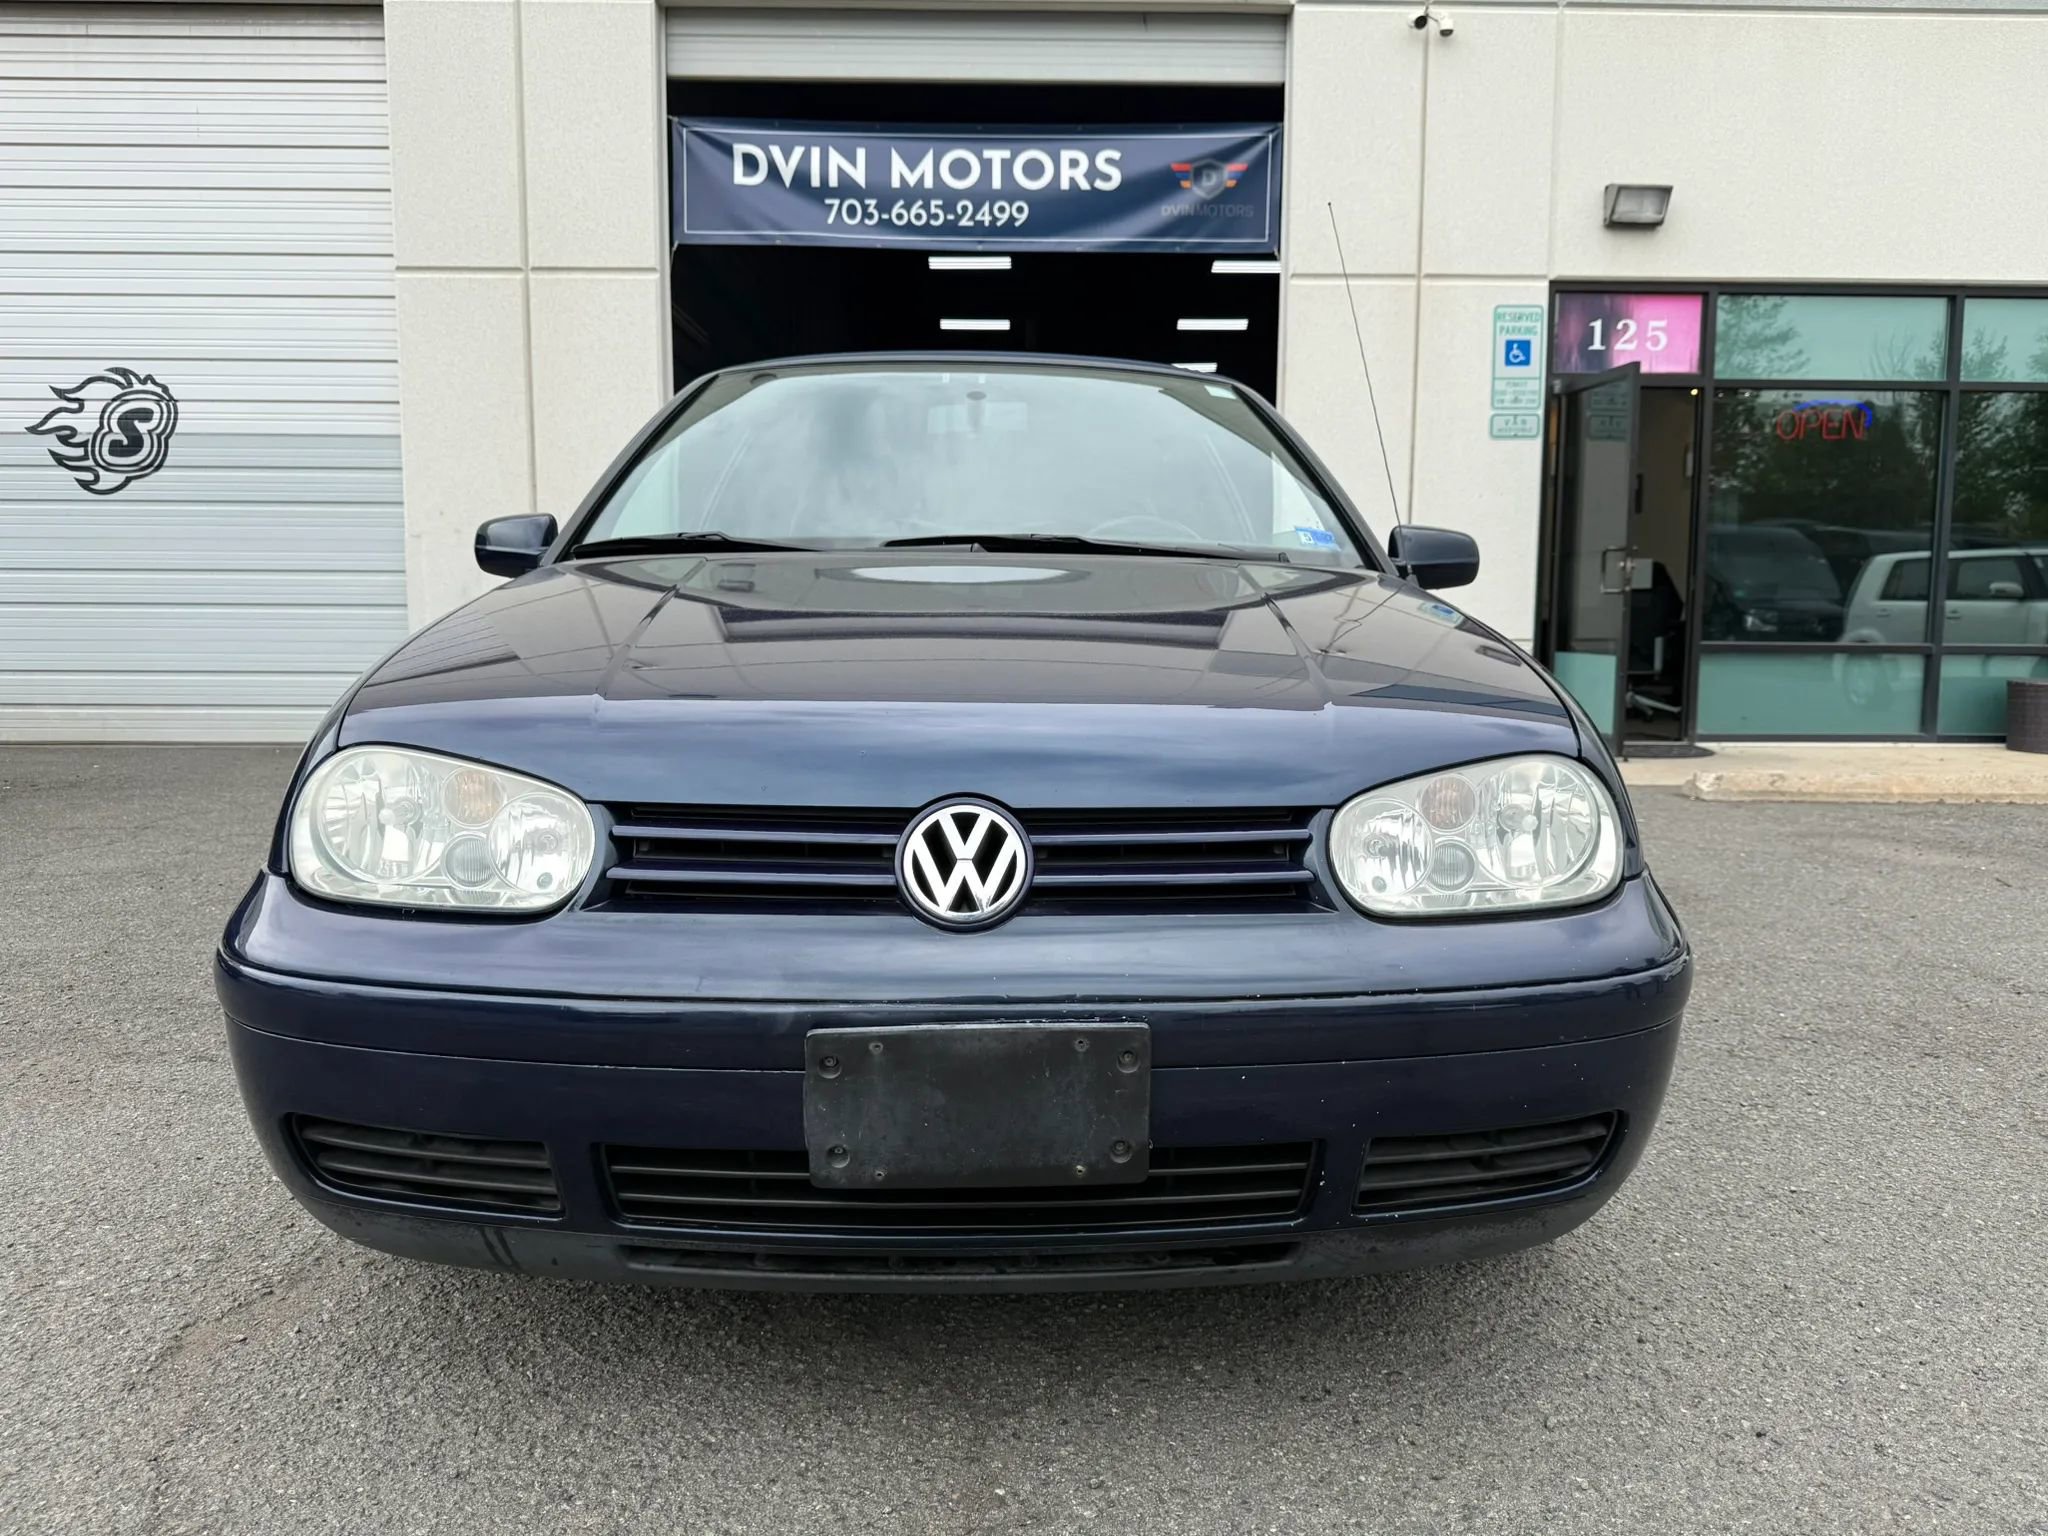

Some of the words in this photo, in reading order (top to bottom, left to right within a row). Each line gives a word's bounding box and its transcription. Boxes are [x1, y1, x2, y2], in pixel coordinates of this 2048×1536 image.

[732, 143, 867, 190] DVIN
[890, 147, 1123, 192] MOTORS
[1202, 169, 1216, 186] D
[824, 198, 1030, 228] 703-665-2499
[1496, 312, 1542, 323] RESERVED
[1499, 325, 1538, 336] PARKING
[1587, 318, 1670, 353] 125
[1776, 408, 1866, 441] OPEN
[903, 804, 1026, 921] VW
